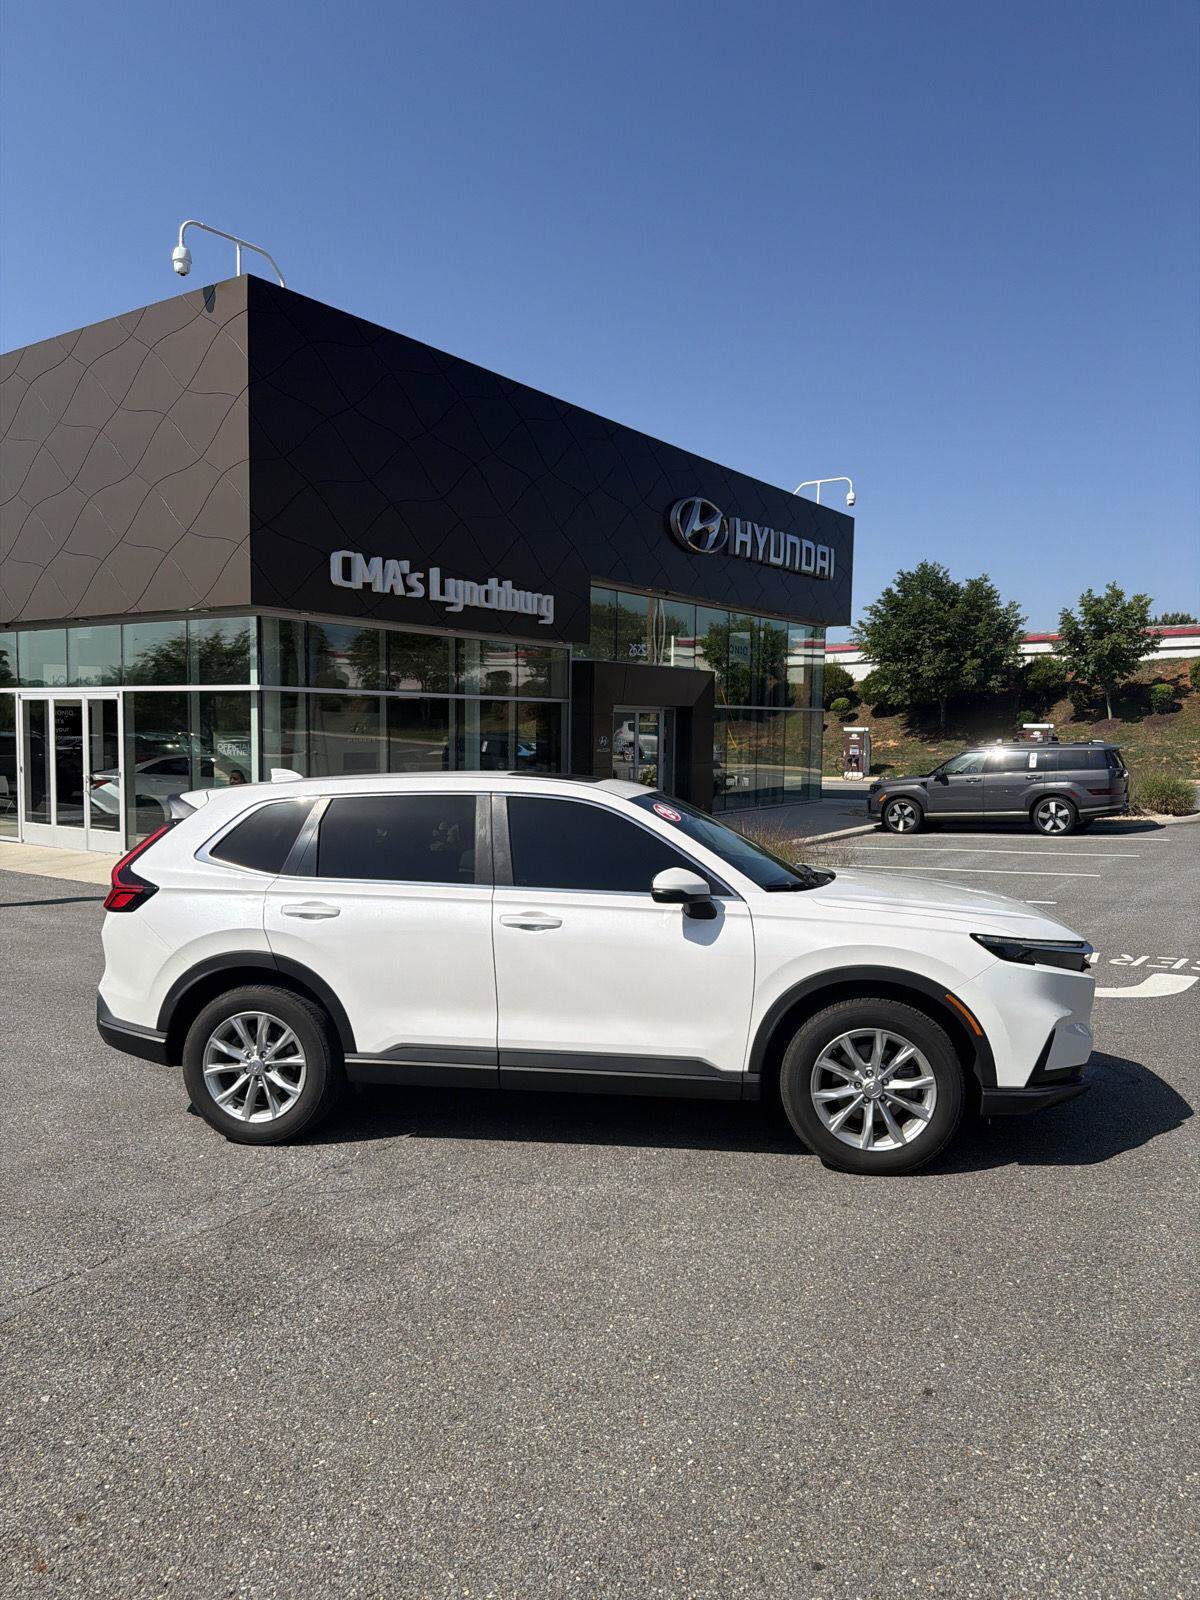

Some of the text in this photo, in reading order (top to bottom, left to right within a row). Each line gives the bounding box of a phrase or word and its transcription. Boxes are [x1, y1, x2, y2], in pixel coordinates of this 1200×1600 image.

[729, 516, 834, 580] HYUNDAI
[330, 550, 554, 624] CMA's Lynchburg
